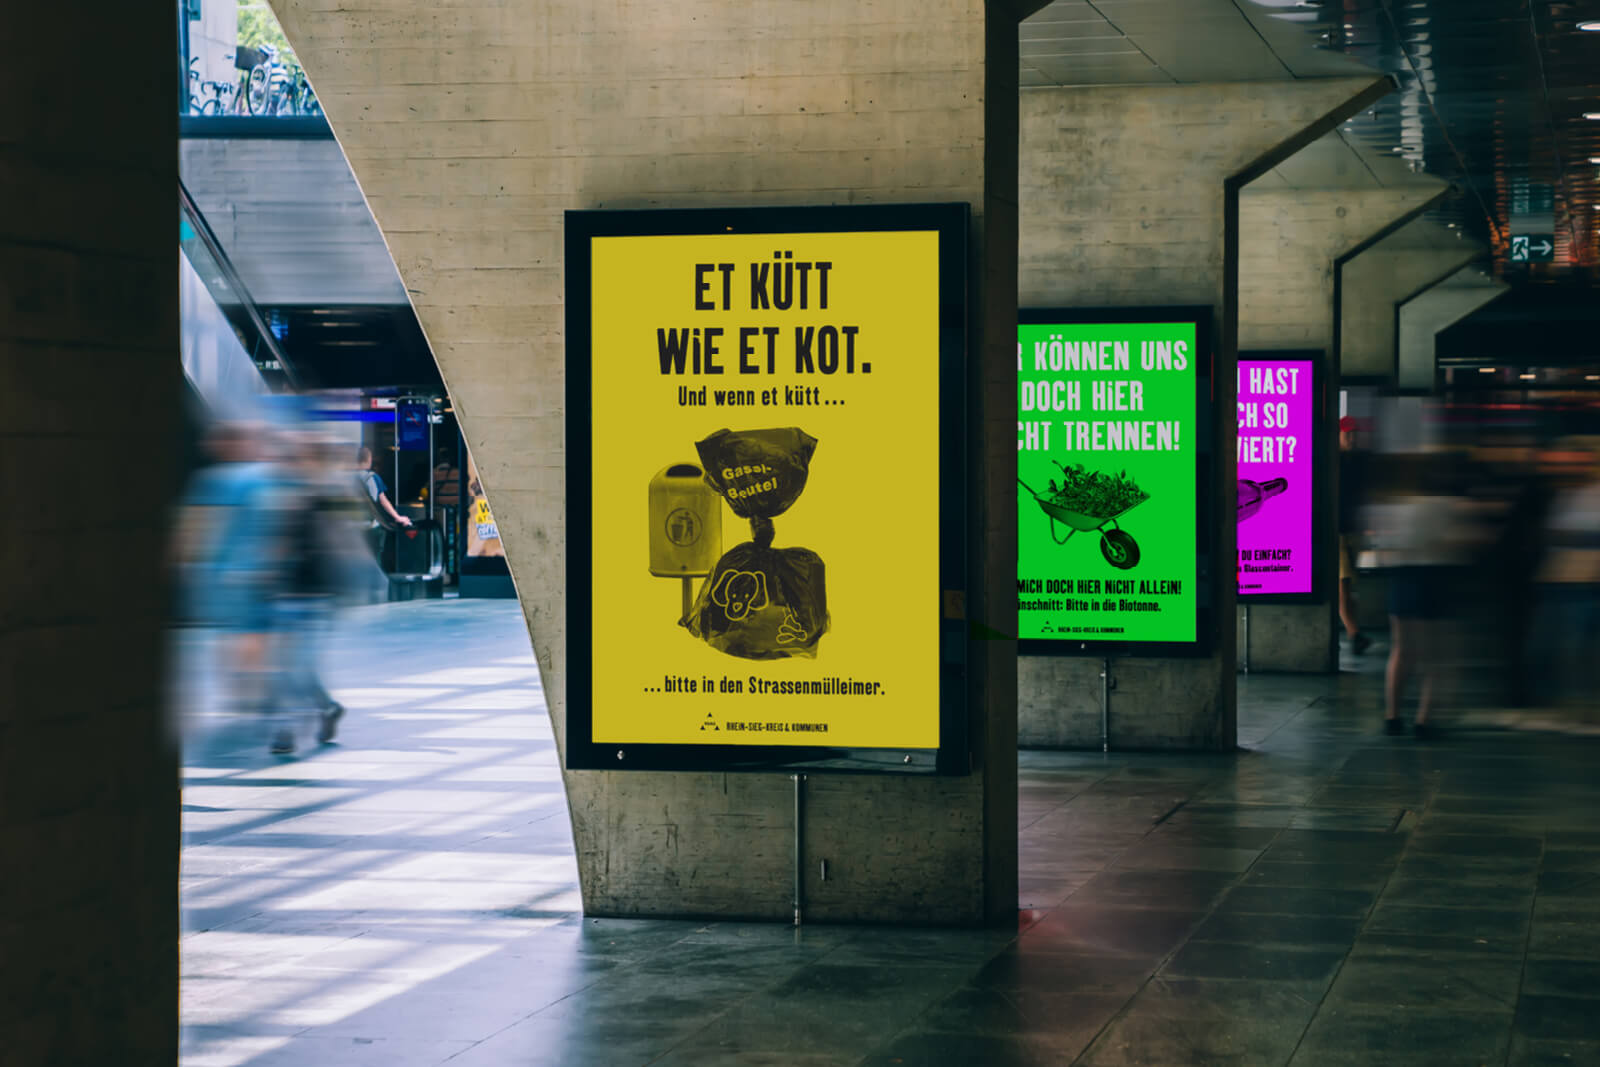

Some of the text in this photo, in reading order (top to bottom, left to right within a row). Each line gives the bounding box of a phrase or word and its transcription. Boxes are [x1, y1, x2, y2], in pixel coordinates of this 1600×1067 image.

[695, 250, 832, 311] ET KÜTT
[739, 327, 780, 374] ET
[795, 325, 872, 375] KOT.
[1035, 334, 1129, 371] KÖNNEN
[1141, 341, 1187, 371] UNS
[1250, 368, 1299, 394] HAST
[678, 385, 707, 406] Und
[714, 390, 755, 406] wenn
[762, 386, 778, 406] et
[1021, 381, 1080, 411] DOCH
[1263, 402, 1288, 428] SO
[1064, 421, 1180, 451] TRENNEN!
[727, 477, 777, 499] Beutel
[1241, 549, 1252, 561] DU
[1046, 579, 1073, 594] DOCH
[1066, 599, 1088, 611] Bitte
[1091, 599, 1100, 611] in
[1103, 599, 1116, 611] die
[1119, 599, 1162, 611] Biotonne.
[703, 675, 714, 693] in
[720, 675, 743, 693] den
[749, 676, 886, 695] Strassenmülleimer.
